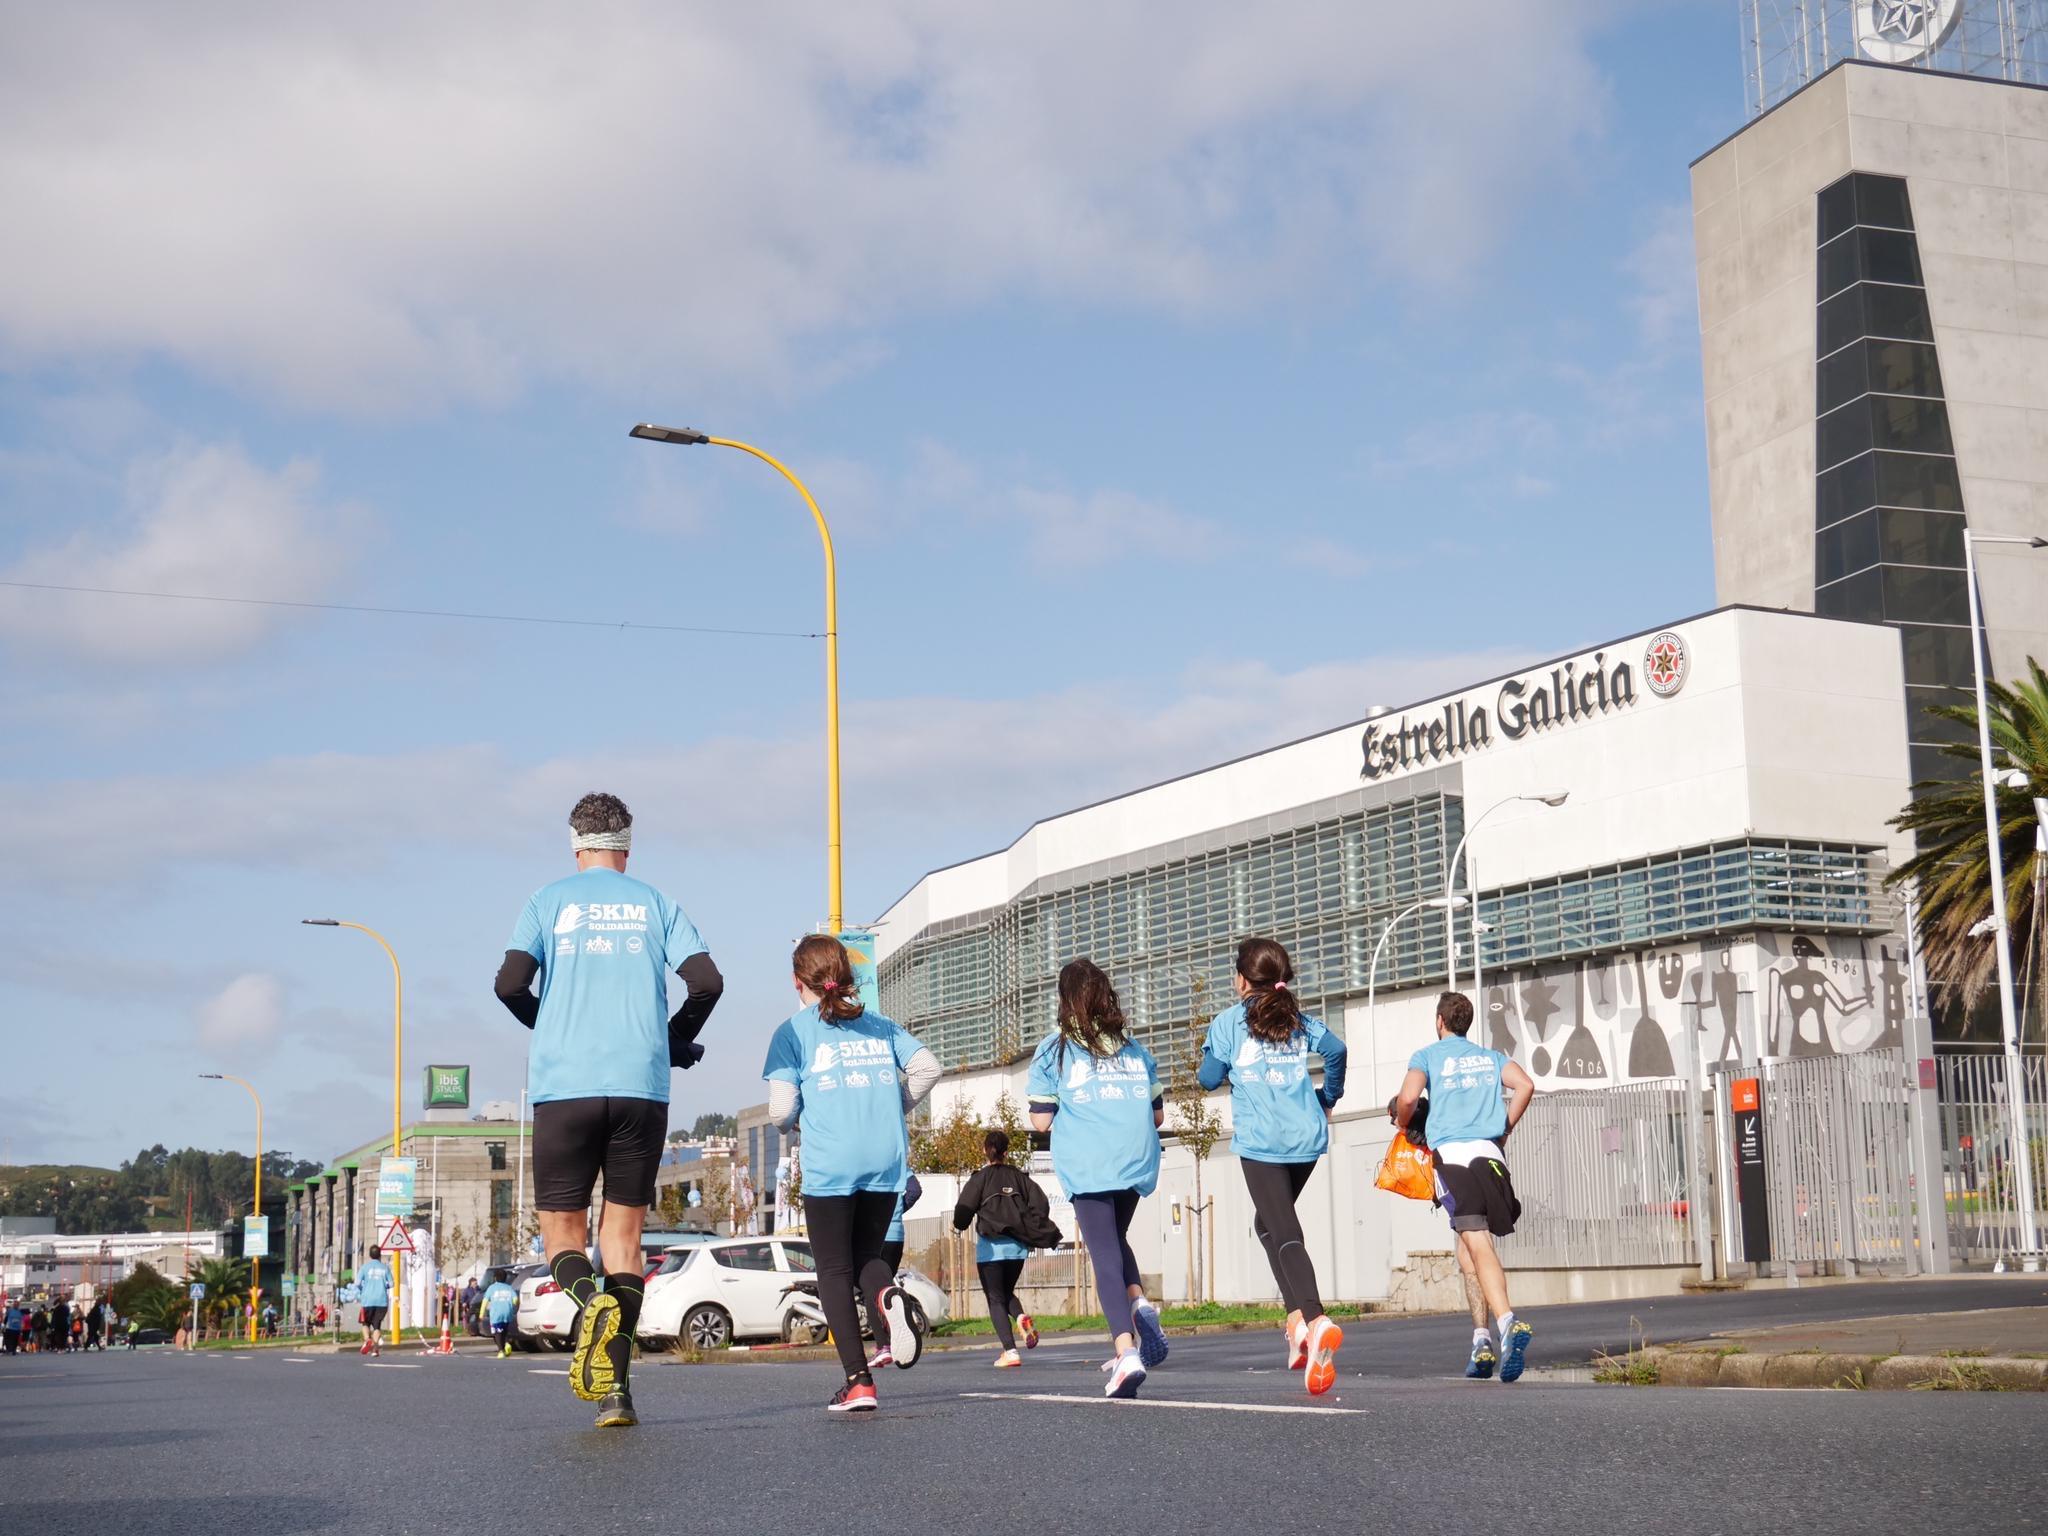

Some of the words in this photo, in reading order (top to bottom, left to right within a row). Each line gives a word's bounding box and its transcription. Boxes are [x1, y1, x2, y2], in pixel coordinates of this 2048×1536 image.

[1360, 698, 1494, 781] Estrella
[1497, 652, 1638, 741] Galicia
[589, 903, 647, 921] 5KM
[1821, 957, 1857, 976] 1906
[839, 1039, 890, 1057] 5KM
[1459, 1056, 1494, 1068] 5KM
[1563, 1058, 1602, 1076] 1906
[440, 1074, 460, 1086] ibis
